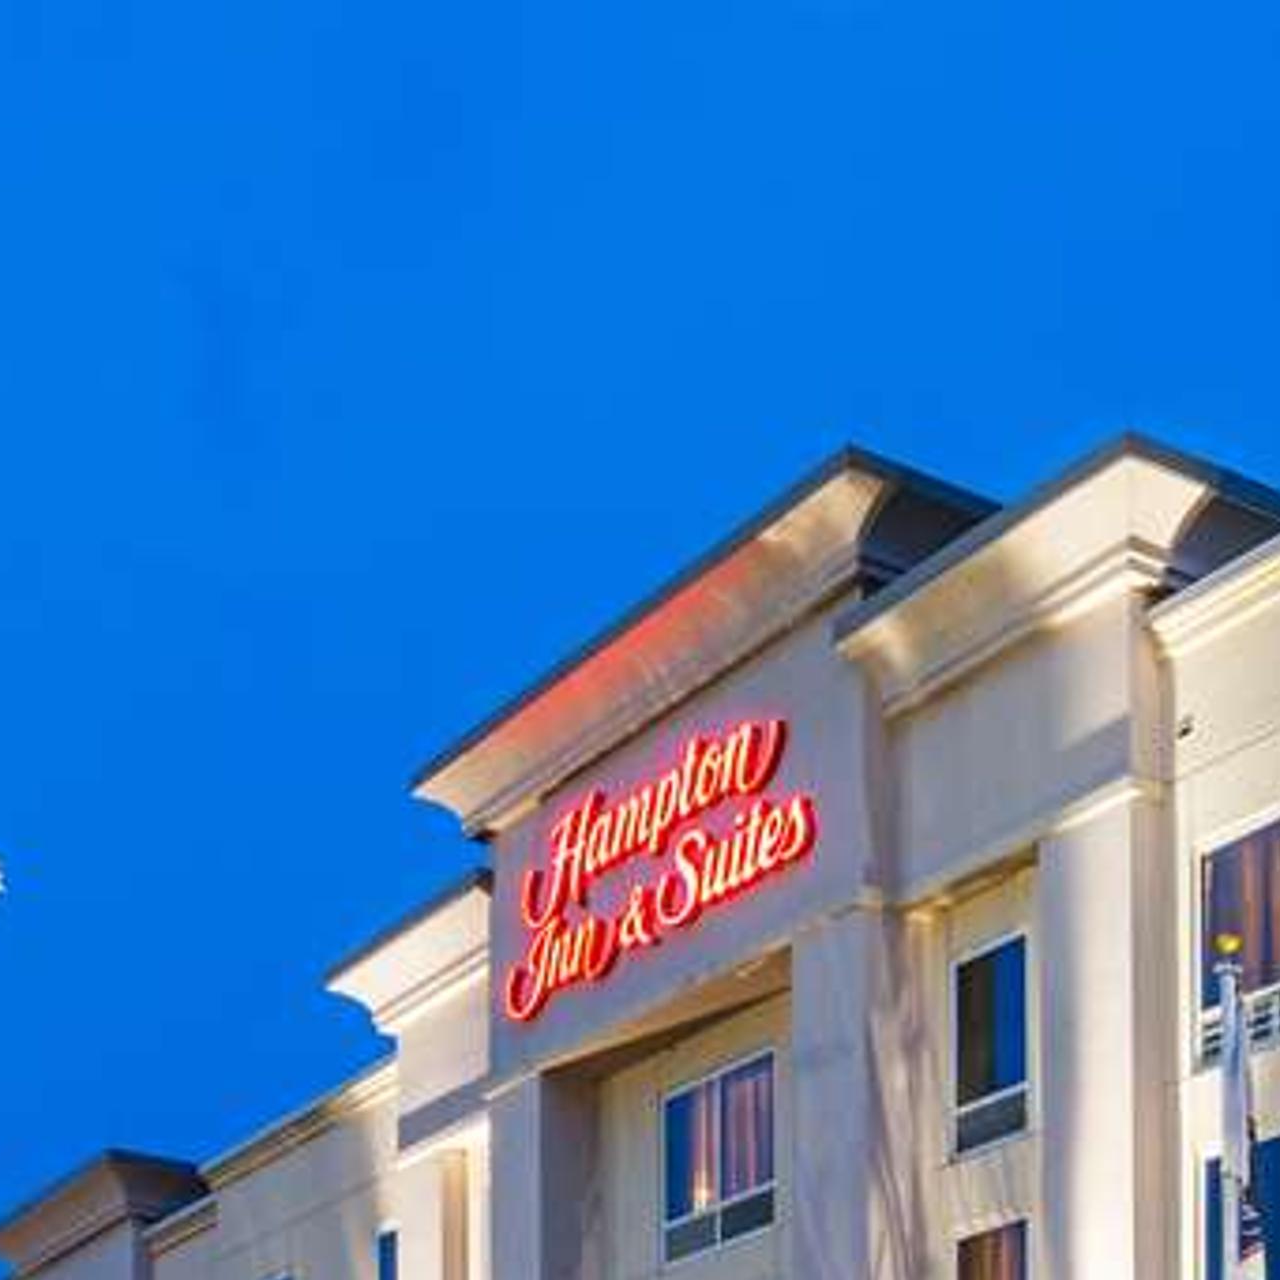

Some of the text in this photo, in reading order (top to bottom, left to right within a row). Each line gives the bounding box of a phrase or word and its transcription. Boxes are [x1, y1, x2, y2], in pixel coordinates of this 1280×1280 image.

[505, 792, 817, 1021] Inn & Suites
[523, 718, 786, 930] Hampton
